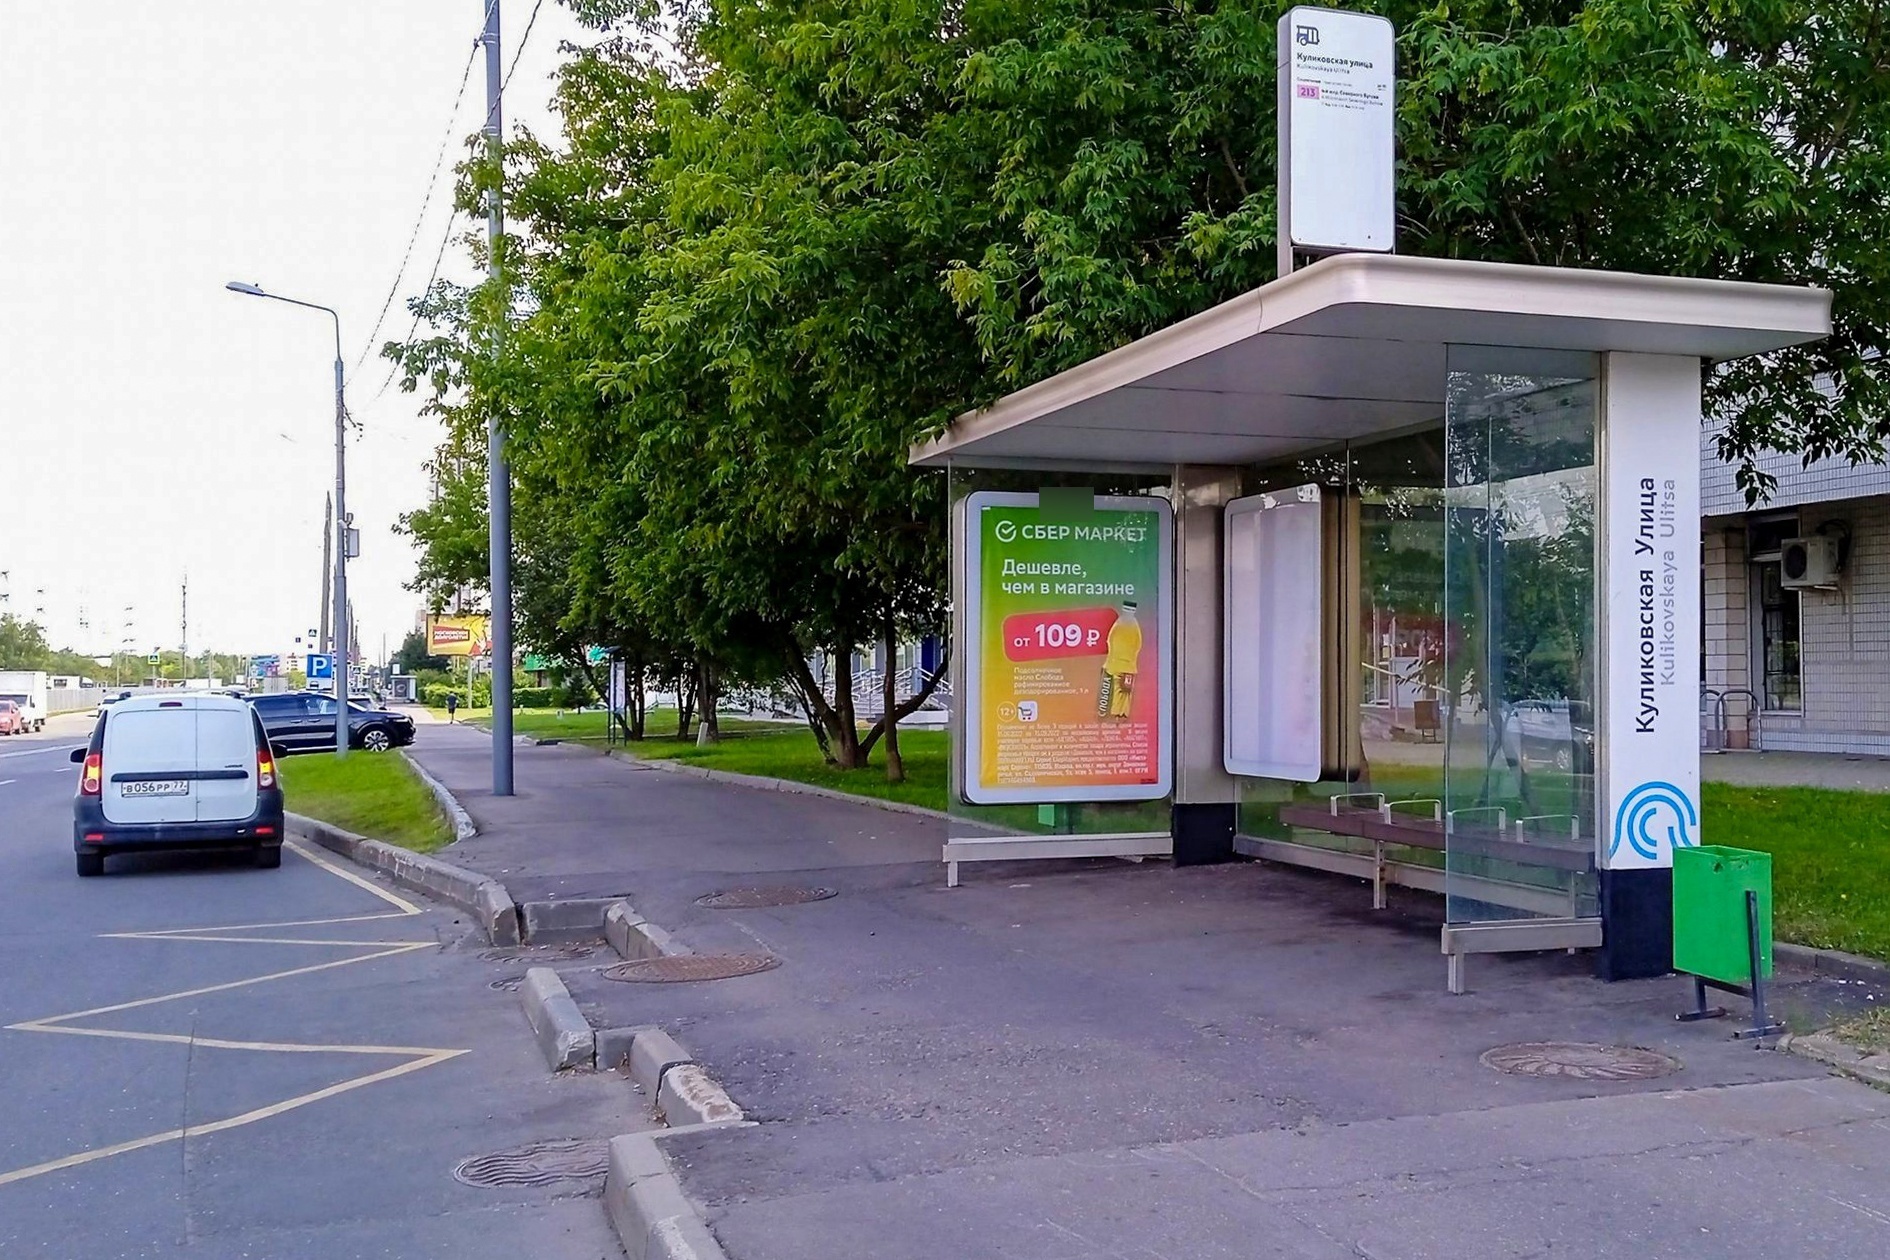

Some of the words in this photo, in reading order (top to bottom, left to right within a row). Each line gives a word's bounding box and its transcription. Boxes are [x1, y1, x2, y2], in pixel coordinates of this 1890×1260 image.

[1297, 52, 1348, 66] Куликовская
[1349, 60, 1373, 69] улица
[1300, 87, 1316, 98] 213
[1635, 477, 1658, 555] Улица
[1660, 479, 1675, 538] Ulitsa
[1021, 524, 1070, 540] СБЕР
[1074, 525, 1147, 542] МАРКЕТ
[1002, 559, 1088, 578] Дешевле,
[1002, 582, 1035, 595] чем
[1040, 582, 1050, 595] в
[1055, 583, 1135, 596] магазине
[1659, 551, 1678, 686] Kulikovskaya
[1013, 636, 1030, 647] от
[1035, 623, 1082, 648] 109
[1635, 570, 1659, 732] Куликовская
